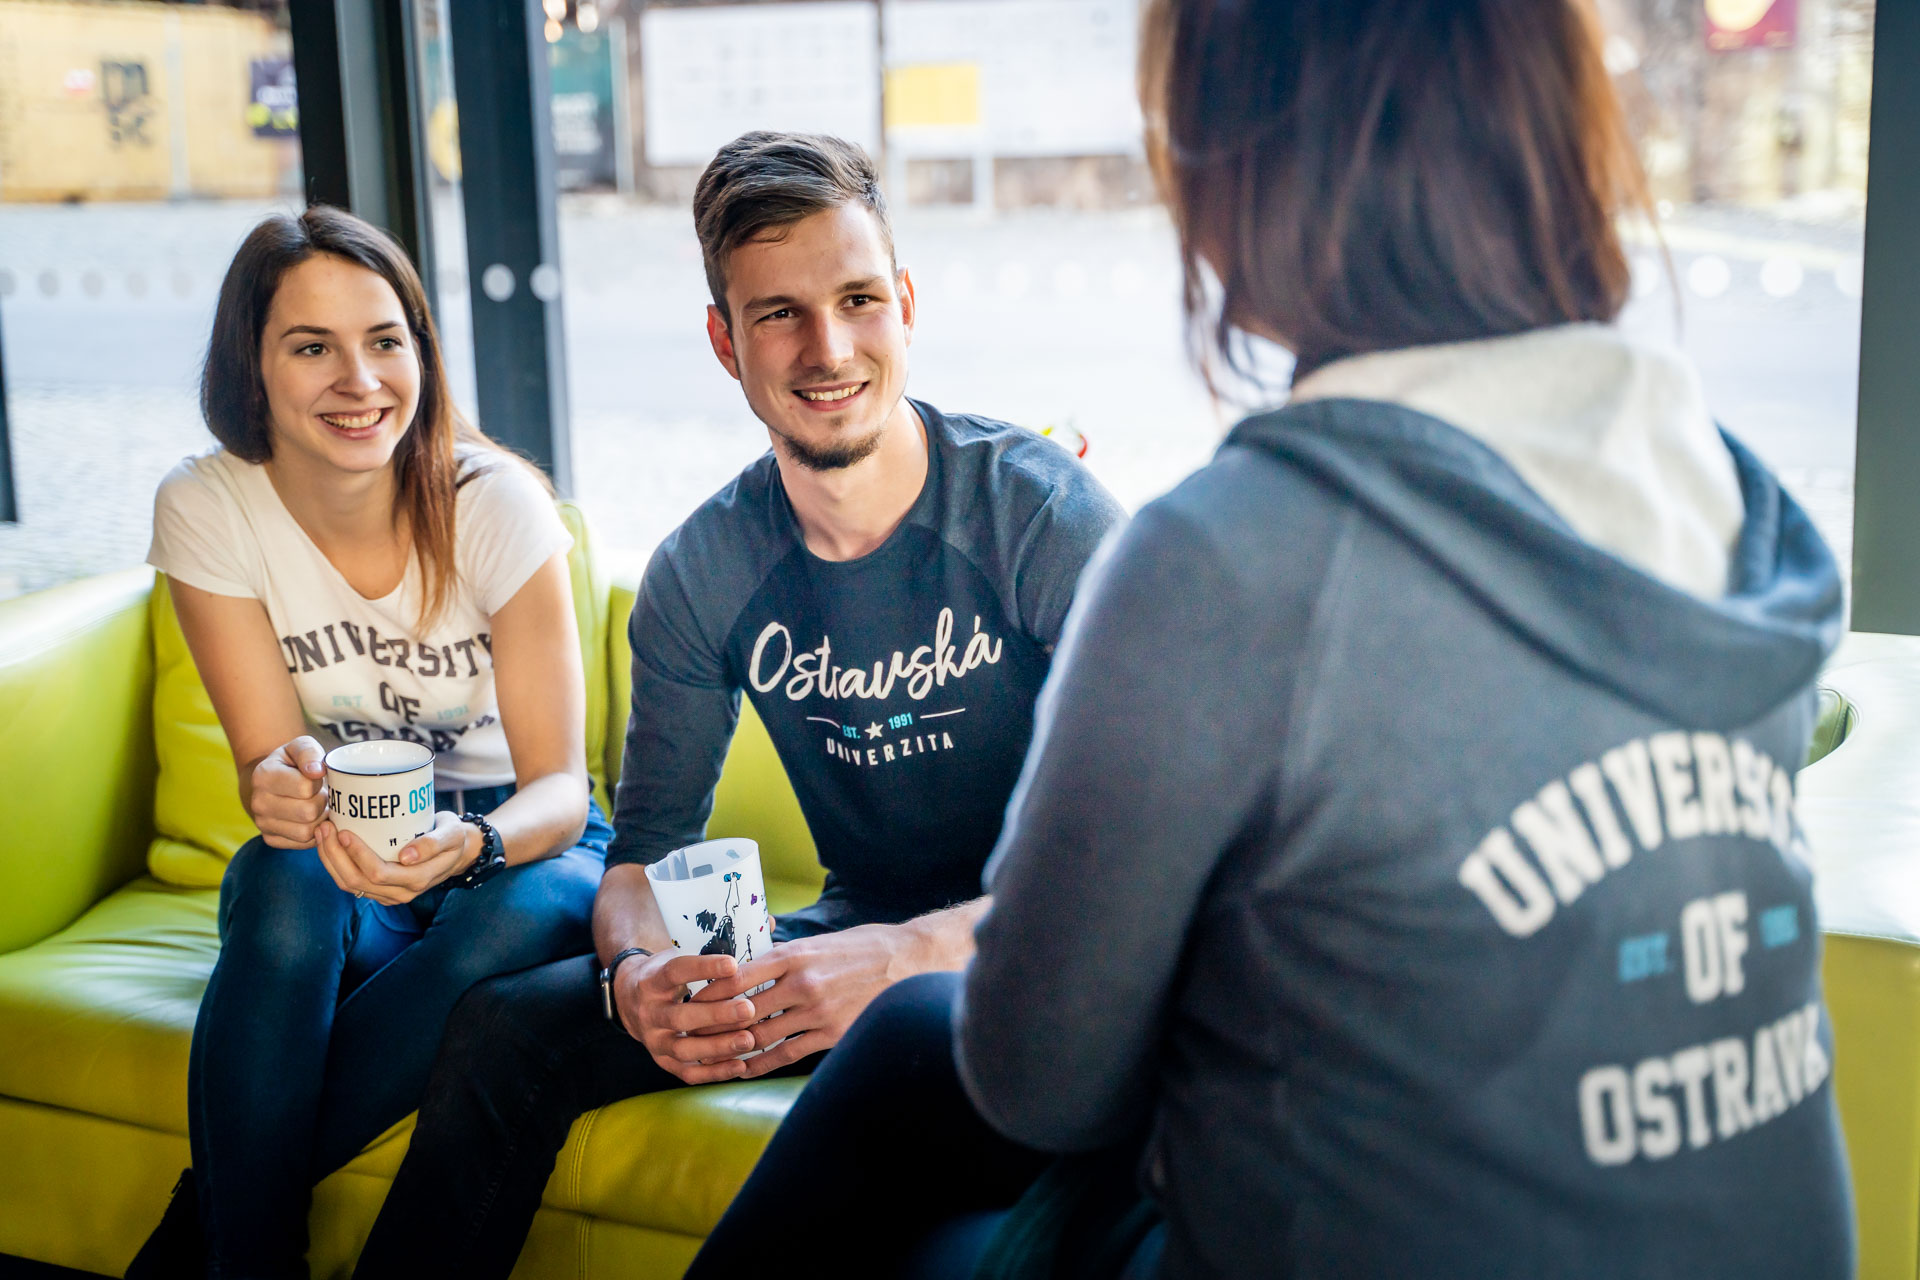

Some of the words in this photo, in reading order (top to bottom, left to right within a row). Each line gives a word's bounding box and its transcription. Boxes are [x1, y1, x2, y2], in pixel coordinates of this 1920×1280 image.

[749, 607, 1002, 700] Ostravská
[378, 681, 421, 724] OF
[842, 724, 861, 739] EST.
[888, 712, 913, 730] 1991
[348, 793, 405, 819] SLEEP.
[1681, 891, 1749, 1003] OF
